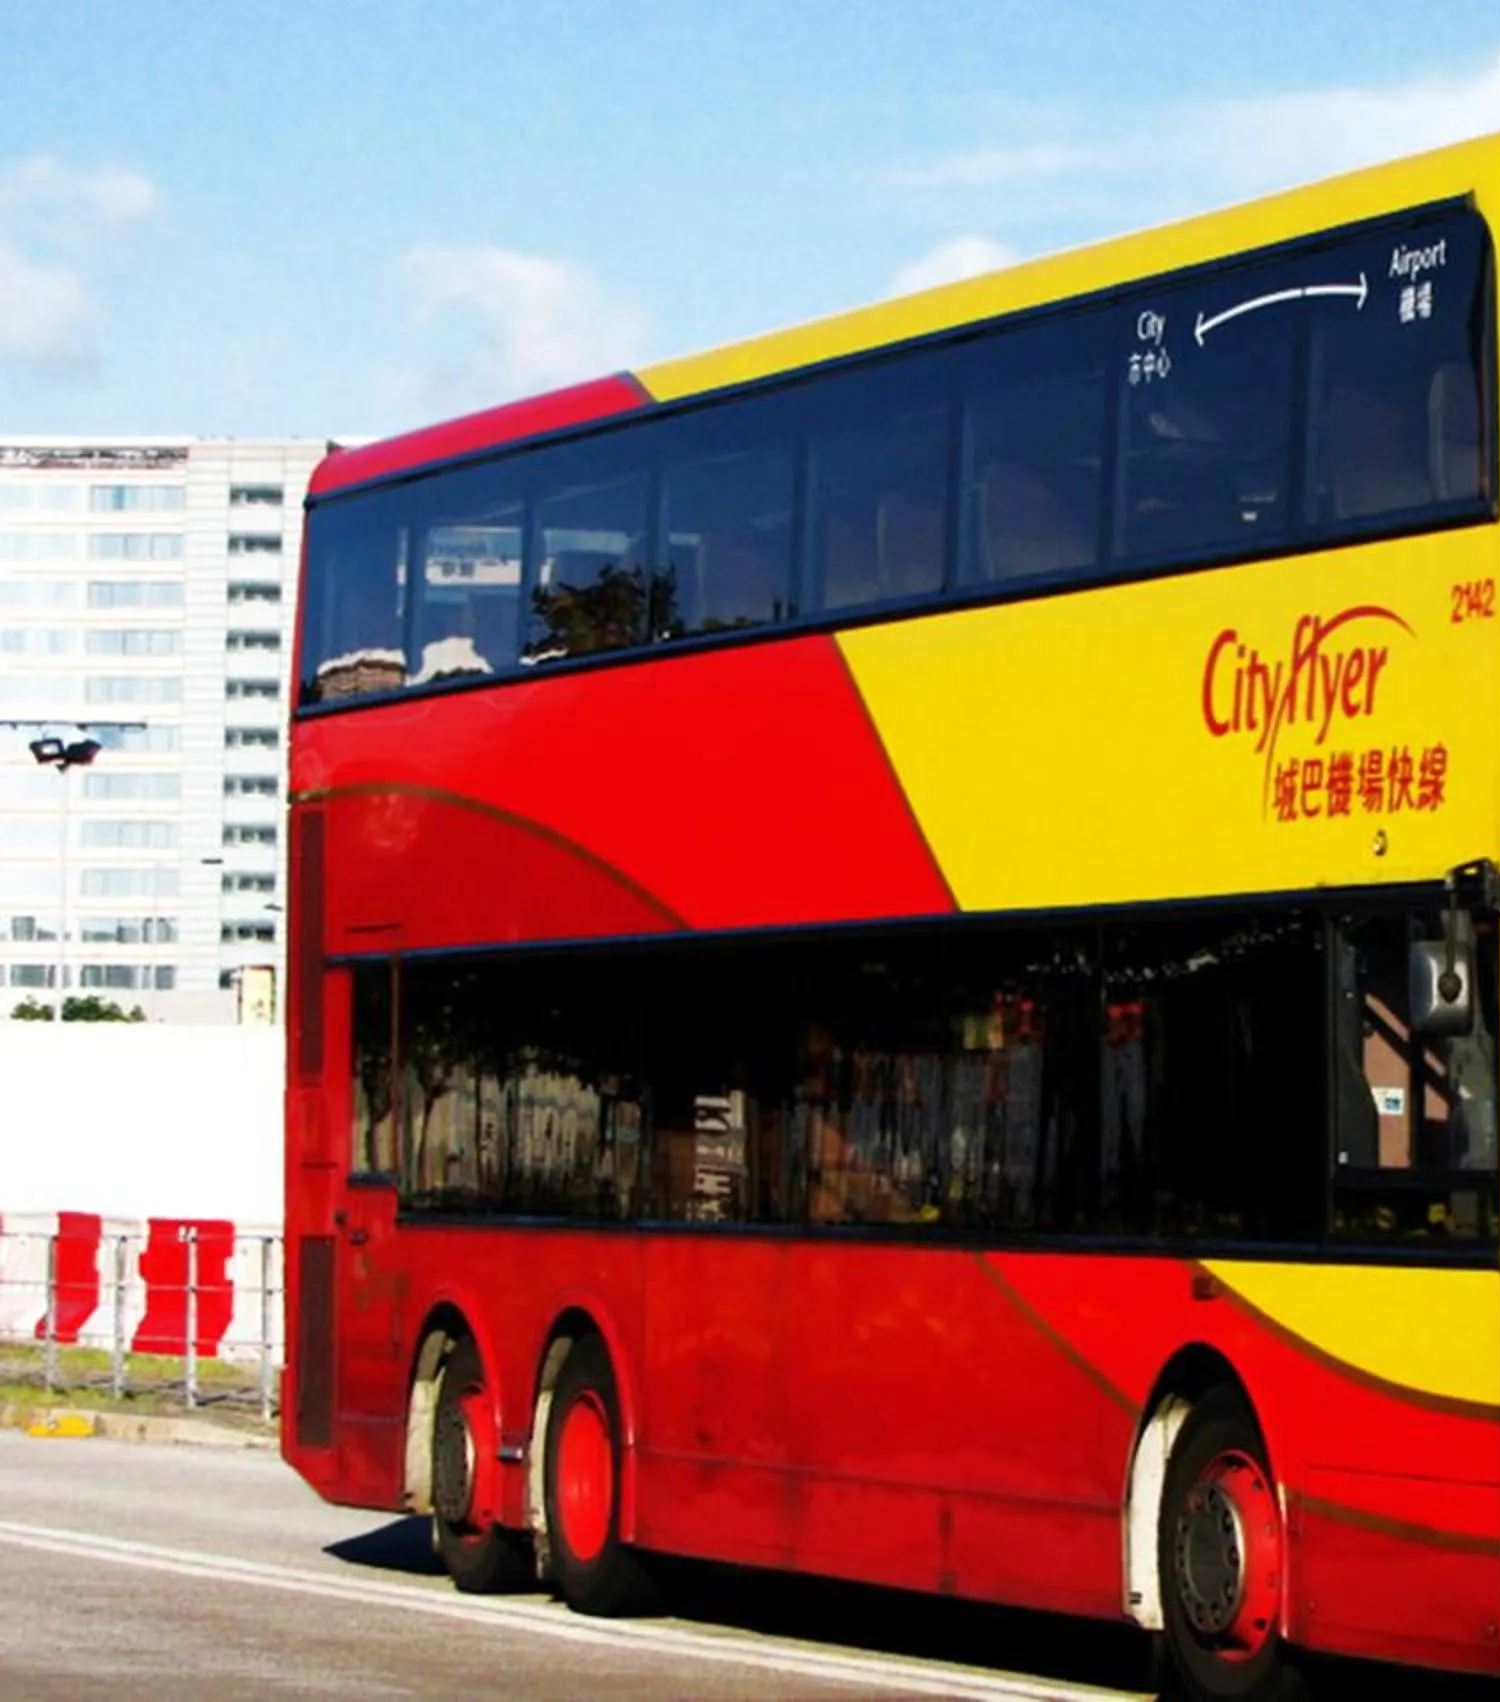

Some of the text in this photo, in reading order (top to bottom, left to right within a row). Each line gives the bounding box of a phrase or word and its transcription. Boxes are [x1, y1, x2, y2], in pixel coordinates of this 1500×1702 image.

[1389, 239, 1447, 280] Airport
[1137, 310, 1165, 344] City
[1451, 579, 1496, 625] 2142
[1202, 606, 1390, 754] Cityflyer
[1274, 743, 1448, 821] 城巴機場快線
